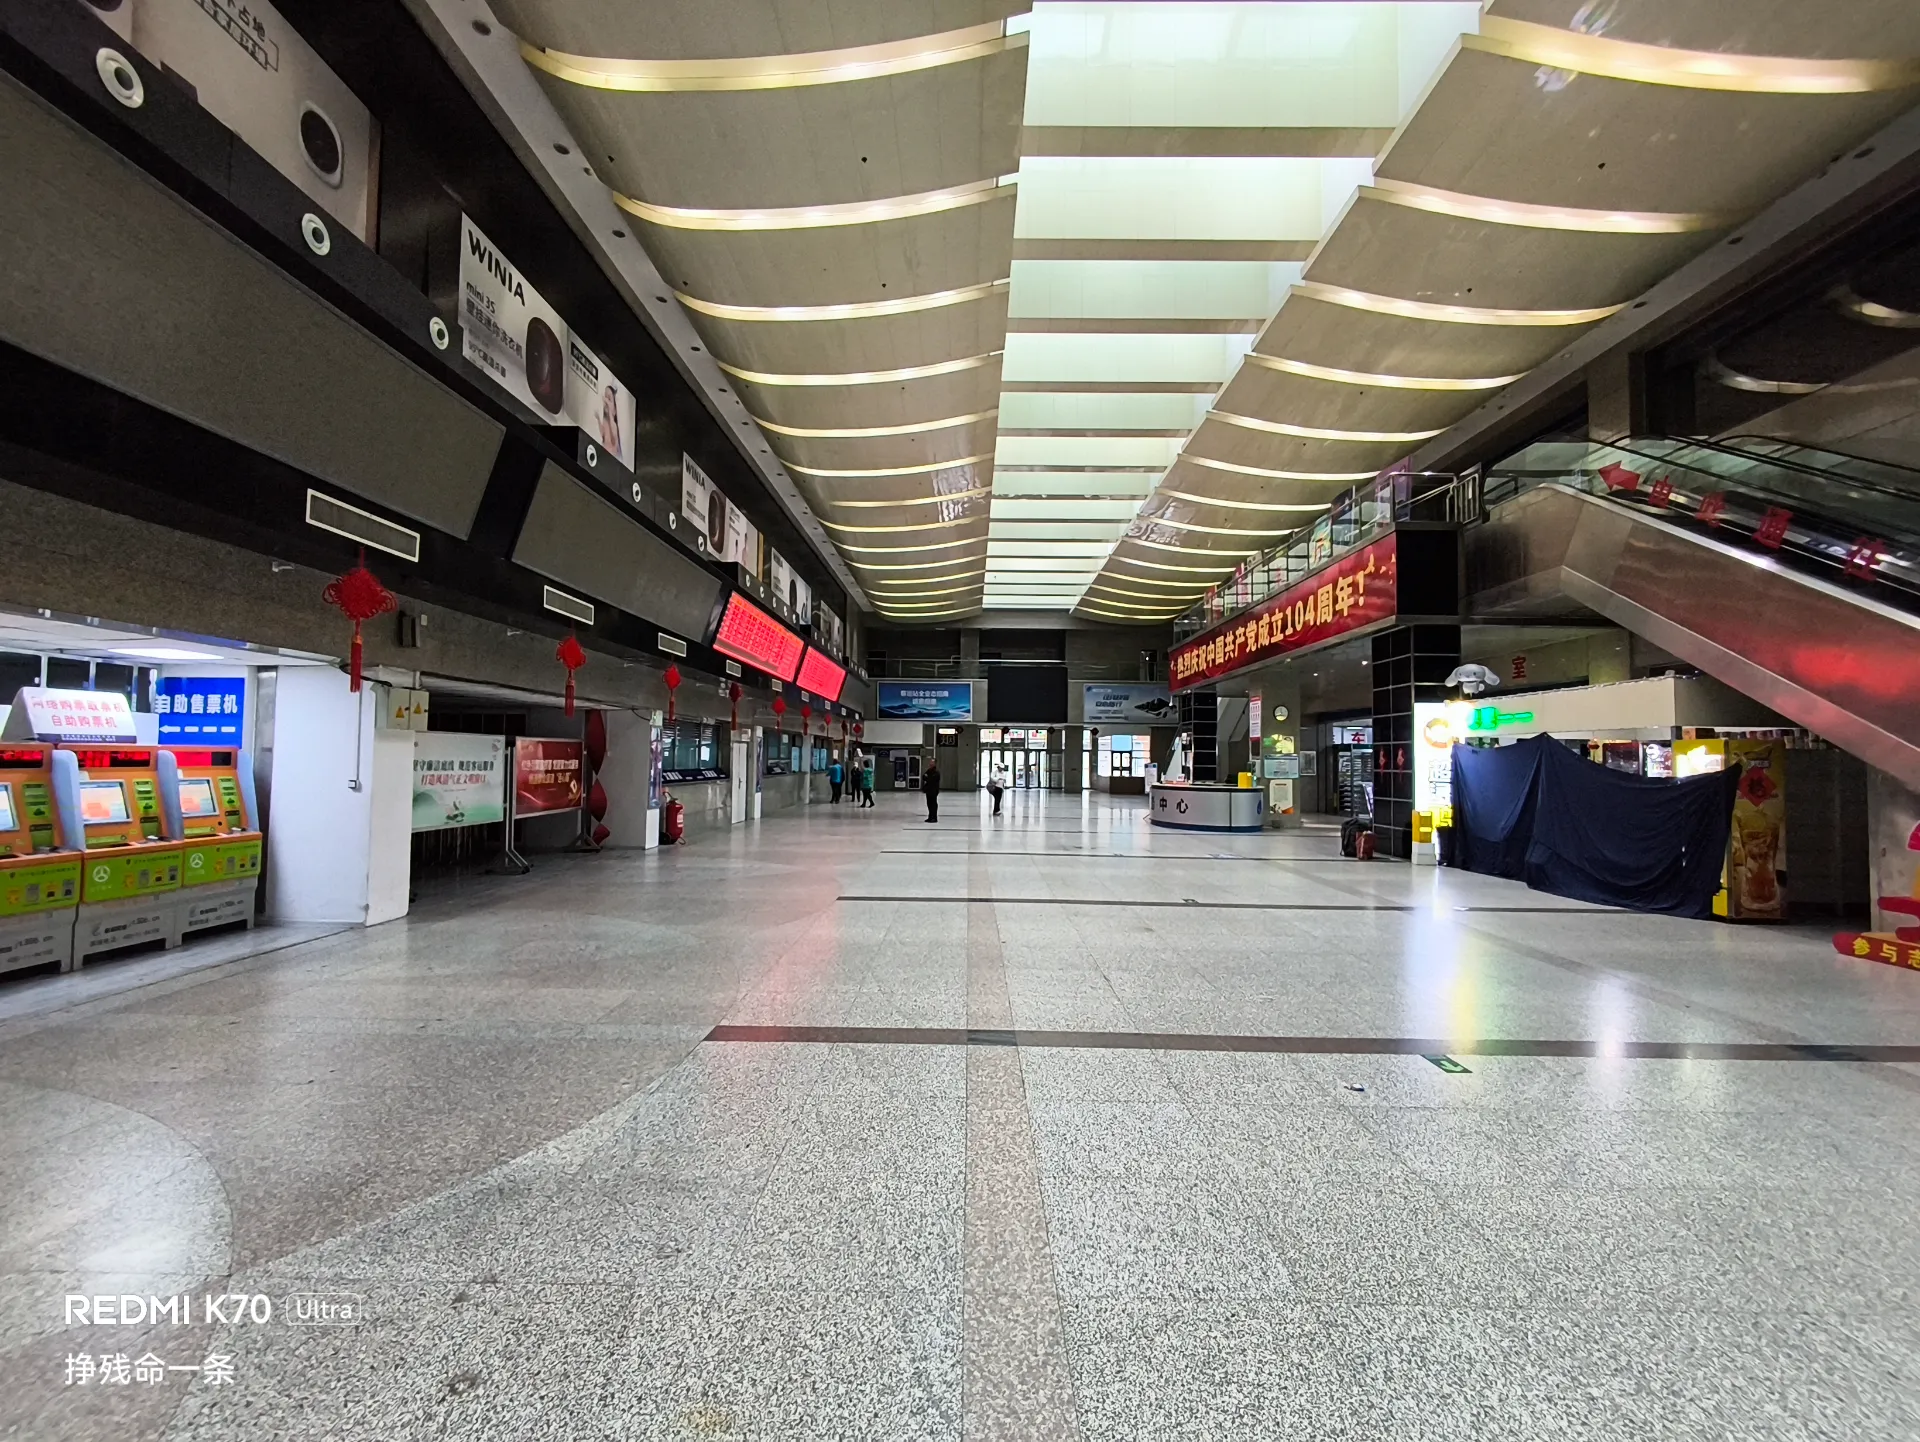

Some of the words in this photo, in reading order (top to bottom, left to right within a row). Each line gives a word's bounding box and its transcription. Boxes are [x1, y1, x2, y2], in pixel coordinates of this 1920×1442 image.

[467, 228, 526, 307] WINIA
[466, 281, 485, 302] mini
[1176, 570, 1366, 681] 热烈庆祝中国共产党成立104周年！
[1511, 655, 1527, 680] 室
[155, 693, 239, 715] 自助售票机
[51, 715, 118, 729] 自助购票机
